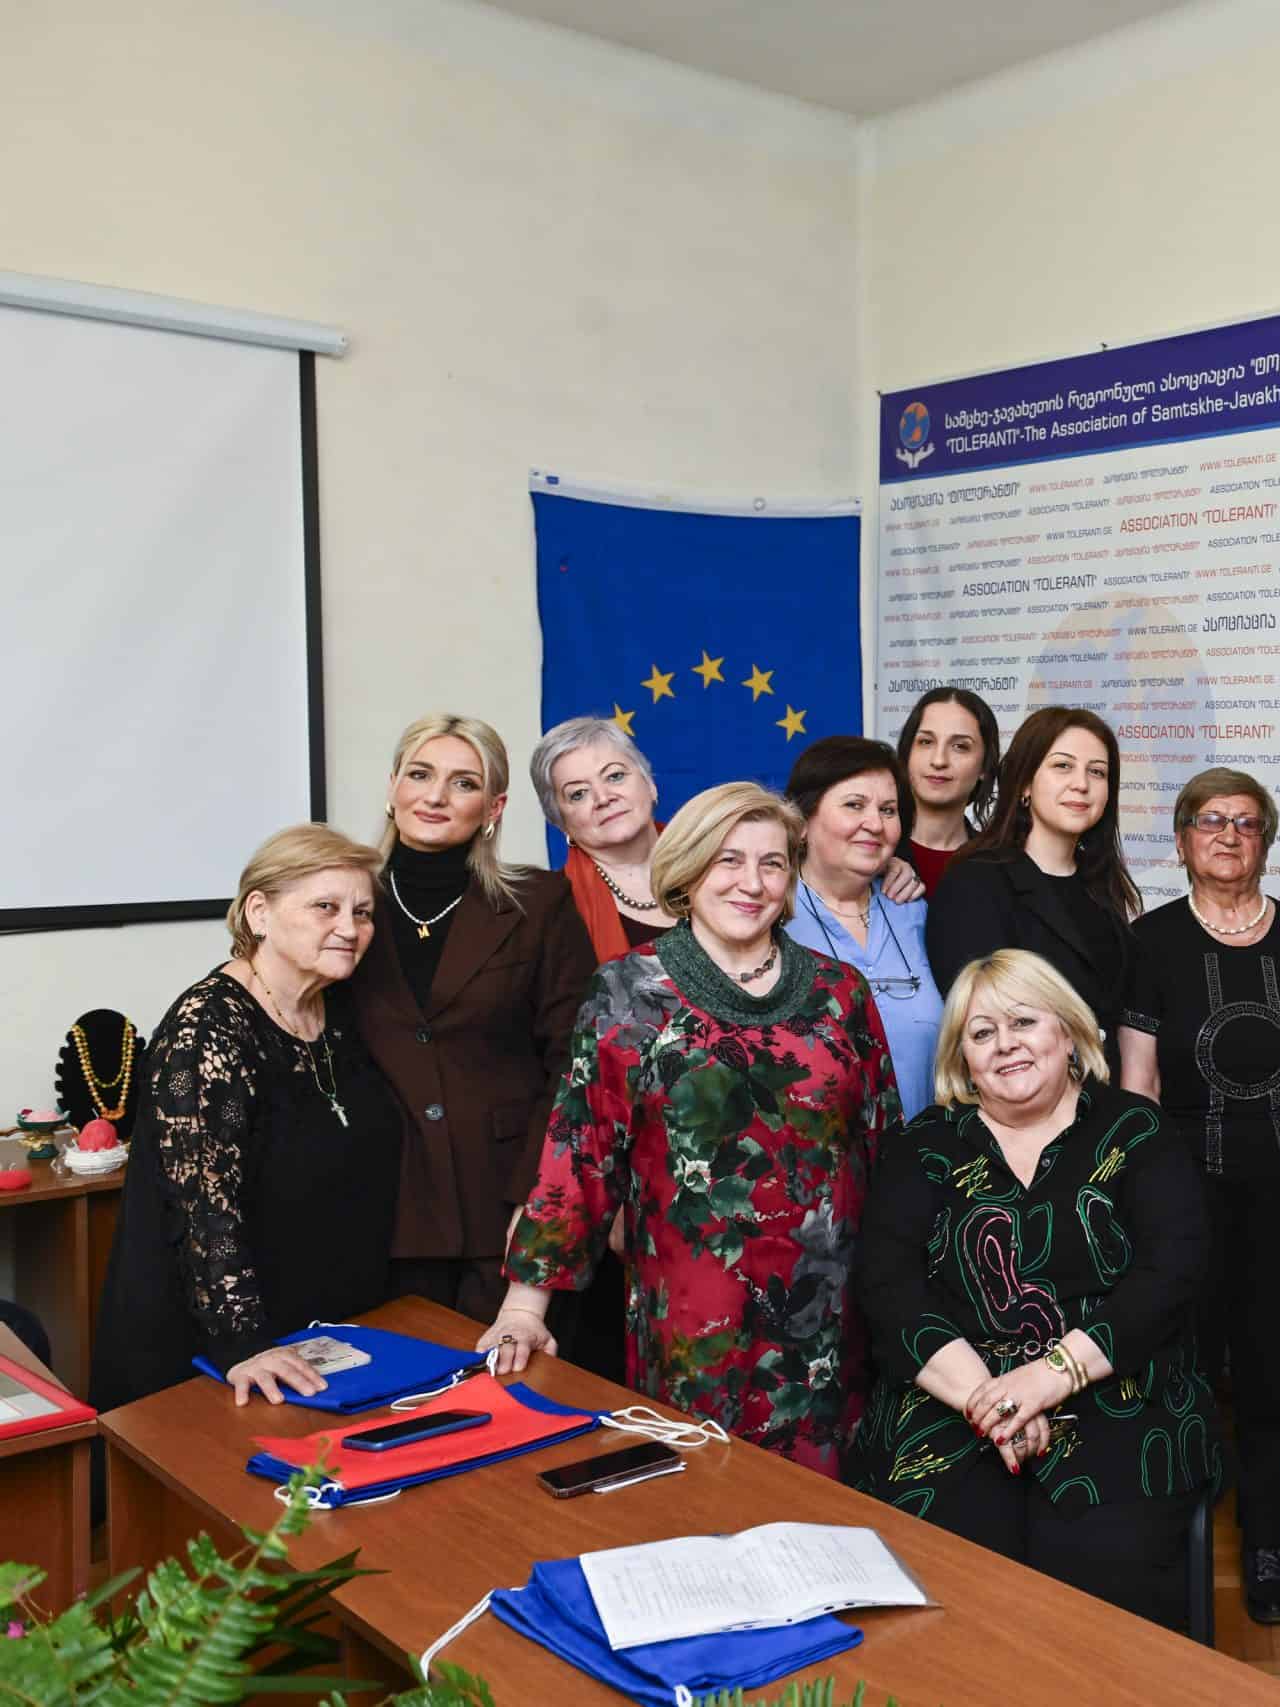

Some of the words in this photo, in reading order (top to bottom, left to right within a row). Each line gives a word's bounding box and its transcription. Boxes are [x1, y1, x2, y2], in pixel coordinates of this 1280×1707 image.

[1068, 380, 1156, 410] რეგიონული
[1160, 365, 1246, 392] ასოციაცია
[1050, 414, 1128, 438] Association
[1131, 406, 1149, 425] of
[1119, 511, 1198, 534] ASSOCIATION
[962, 580, 1030, 597] ASSOCIATION
[1117, 725, 1195, 739] ASSOCIATION
